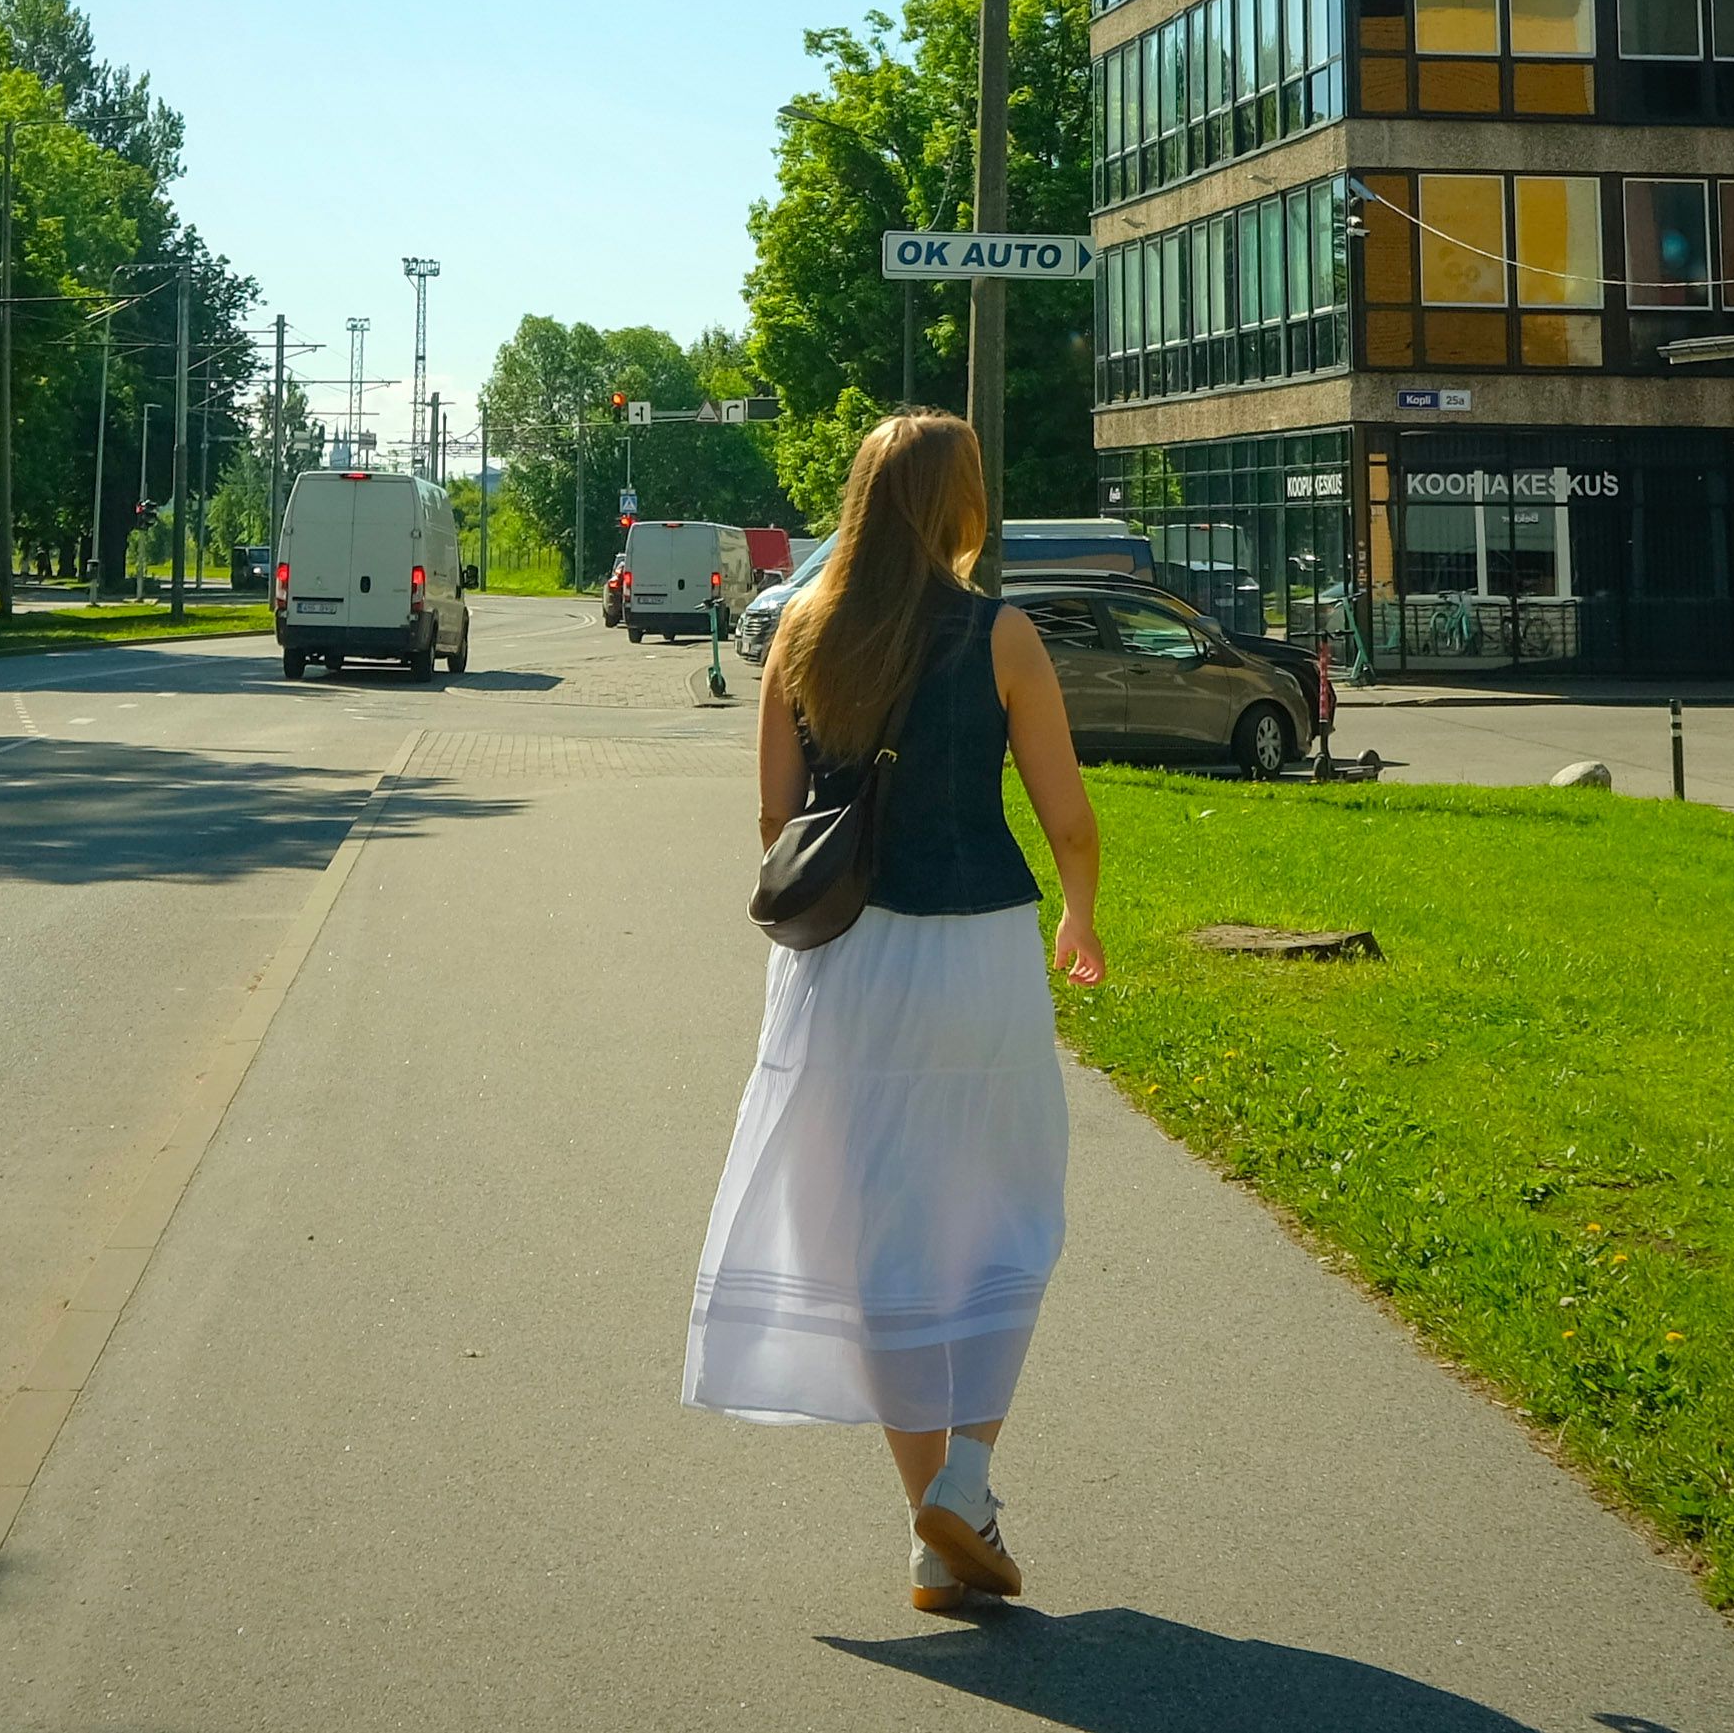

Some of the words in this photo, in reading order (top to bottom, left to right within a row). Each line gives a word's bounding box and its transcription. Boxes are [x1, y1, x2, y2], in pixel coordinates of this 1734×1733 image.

[896, 240, 950, 266] OK
[960, 241, 1062, 269] AUTO
[1406, 394, 1431, 407] Kopli
[1446, 395, 1465, 406] 25a
